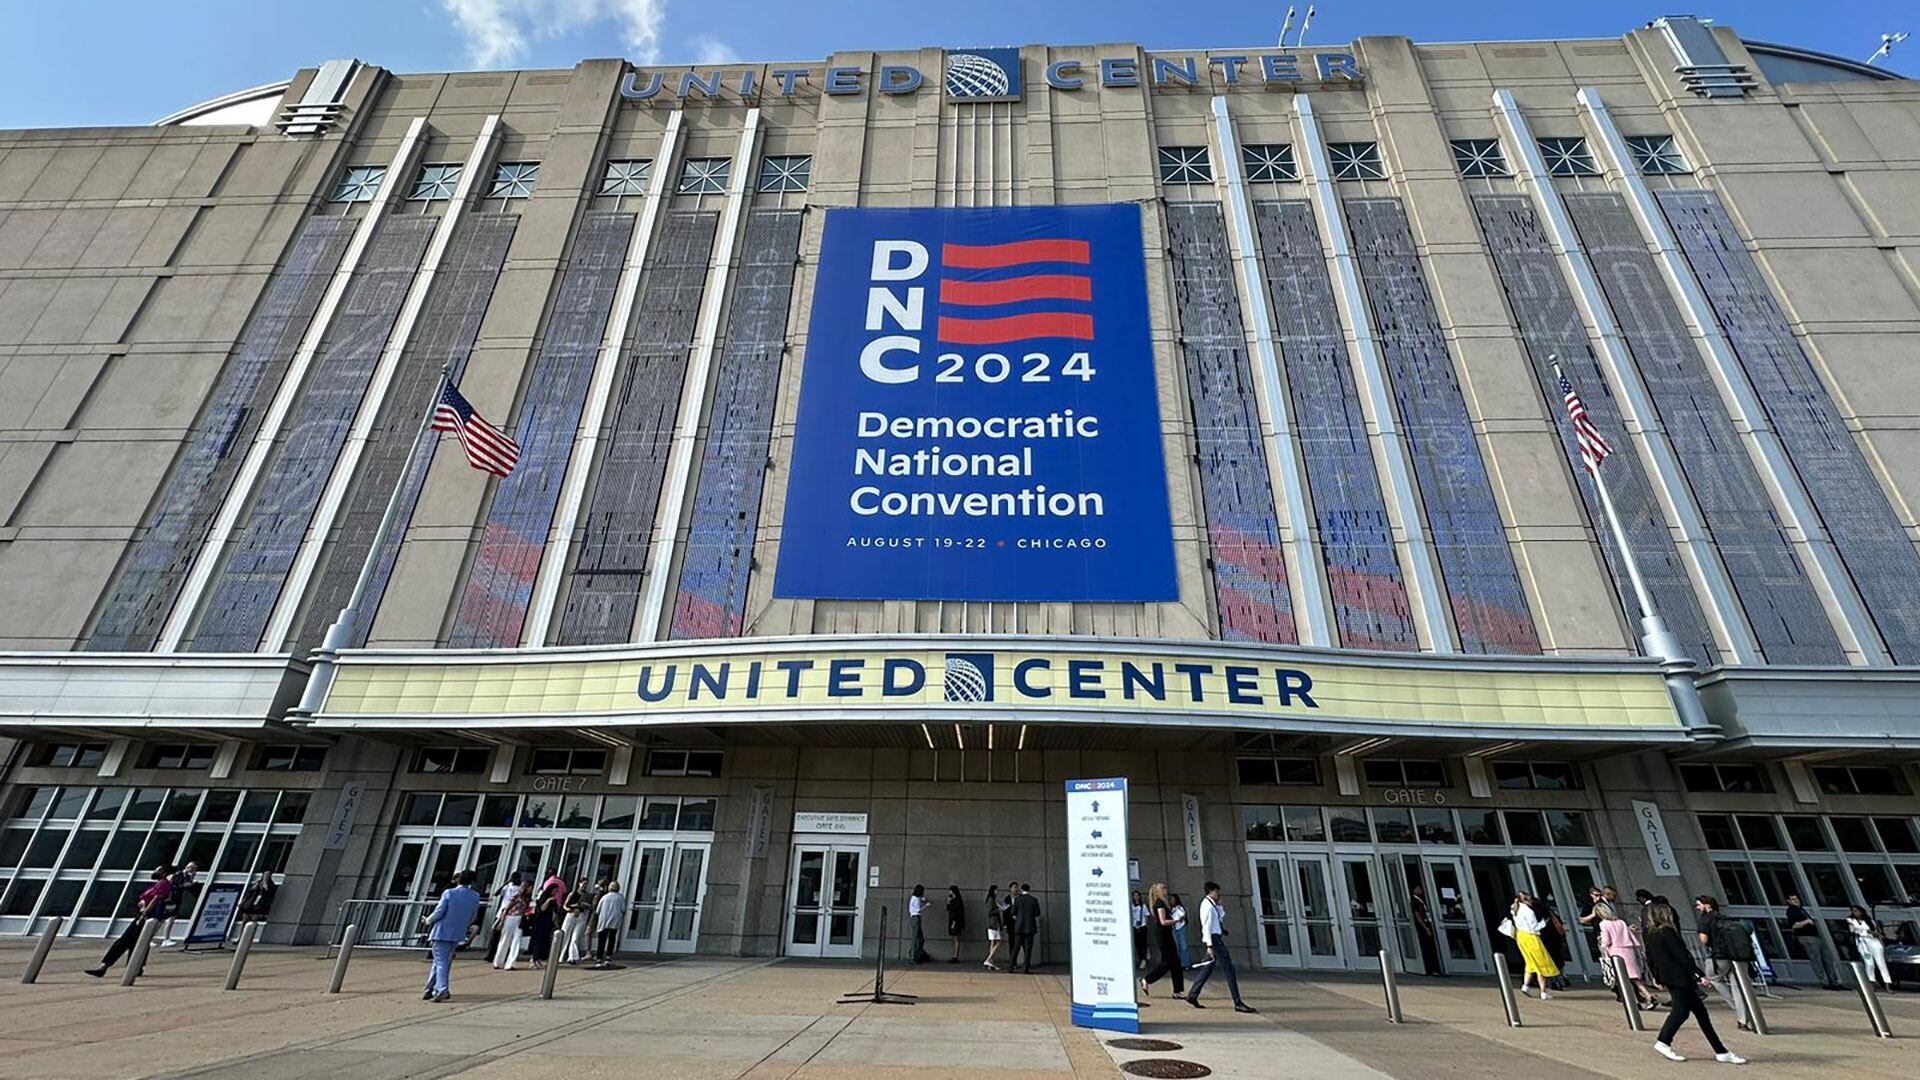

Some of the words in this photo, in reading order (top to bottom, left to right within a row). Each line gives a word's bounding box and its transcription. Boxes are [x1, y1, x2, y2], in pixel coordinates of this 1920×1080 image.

[620, 66, 922, 98] UNITED
[1045, 53, 1365, 89] CENTER
[860, 240, 929, 384] DNC
[935, 352, 1096, 383] 2024
[858, 409, 1098, 438] Democratic
[854, 446, 1032, 476] National
[850, 485, 1103, 516] Convention
[846, 537, 924, 548] AUGUST
[935, 538, 986, 548] 19-22
[1017, 538, 1107, 549] CHICAGO
[638, 658, 926, 702] UNITED
[1013, 658, 1319, 708] CENTER
[533, 777, 571, 791] GATE
[578, 777, 586, 791] 7
[1075, 782, 1092, 790] DNC
[1097, 781, 1115, 789] 2024
[1384, 789, 1427, 804] GATE
[1434, 790, 1446, 805] 6
[338, 786, 359, 831] GATE
[334, 833, 343, 845] 7
[1185, 800, 1196, 847] GATE
[1192, 849, 1199, 861] 6
[1642, 807, 1664, 855] GATE
[1661, 858, 1670, 871] 6
